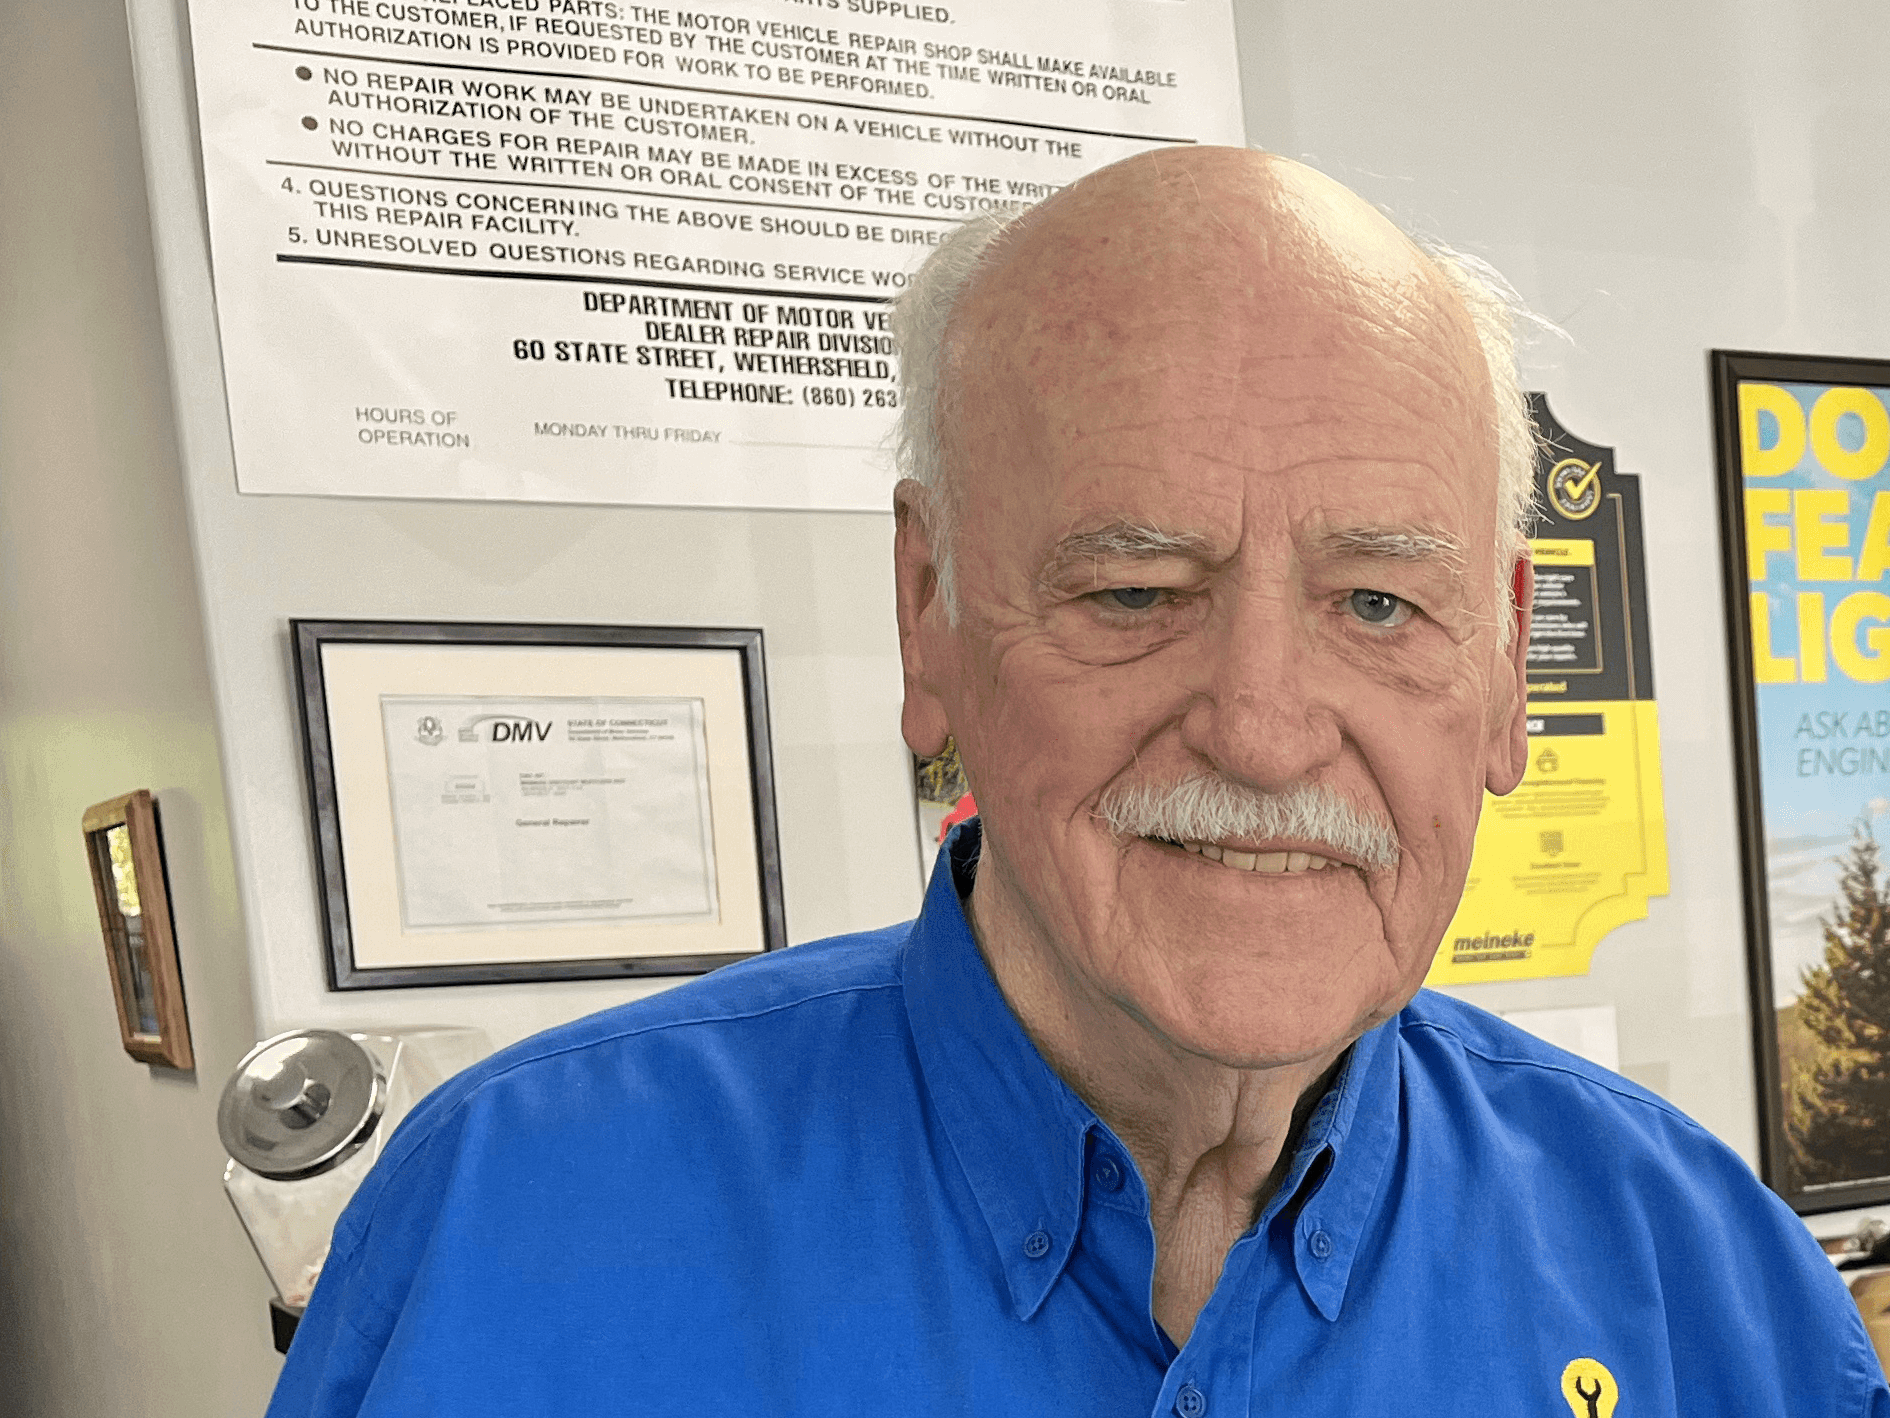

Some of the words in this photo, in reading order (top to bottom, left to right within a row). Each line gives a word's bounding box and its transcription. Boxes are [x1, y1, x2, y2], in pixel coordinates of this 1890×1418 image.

[294, 19, 471, 51] AUTHORIZATION
[480, 37, 499, 54] IS
[507, 39, 616, 63] PROVIDED
[623, 49, 664, 69] FOR
[674, 56, 739, 77] WORK
[745, 63, 772, 81] TO
[778, 67, 804, 84] BE
[810, 70, 934, 99] PERFORMED.
[331, 0, 370, 17] THE
[376, 2, 504, 32] CUSTOMER,
[509, 15, 527, 31] IF
[535, 17, 662, 45] REQUESTED
[669, 32, 696, 49] BY
[705, 35, 745, 54] THE
[751, 40, 860, 68] CUSTOMER
[865, 55, 888, 70] AT
[893, 58, 930, 76] THE
[936, 63, 981, 83] TIME
[987, 69, 1066, 94] WRITTEN
[1072, 81, 1097, 98] OR
[1102, 84, 1151, 104] ORAL
[631, 6, 671, 25] THE
[677, 11, 750, 34] MOTOR
[757, 20, 839, 45] VEHICLE
[848, 32, 917, 54] REPAIR
[924, 42, 972, 61] SHOP
[977, 49, 1033, 70] SHALL
[1037, 56, 1084, 77] MAKE
[1089, 63, 1177, 87] AVAILABLE
[324, 67, 357, 86] NO
[367, 73, 454, 95] REPAIR
[462, 80, 536, 103] WORK
[544, 87, 592, 106] MAY
[601, 92, 631, 110] BE
[639, 96, 790, 126] UNDERTAKEN
[797, 113, 828, 130] ON
[834, 118, 849, 133] A
[854, 118, 942, 142] VEHICLE
[948, 128, 1039, 151] WITHOUT
[1045, 139, 1082, 158] THE
[328, 89, 521, 121] AUTHORIZATION
[530, 107, 561, 124] OF
[569, 110, 615, 129] THE
[624, 116, 755, 144] CUSTOMER.
[330, 118, 363, 137] NO
[373, 123, 491, 147] CHARGES
[500, 133, 547, 151] FOR
[557, 137, 640, 160] REPAIR
[648, 146, 693, 165] MAY
[701, 152, 731, 169] BE
[738, 155, 801, 175] MADE
[807, 161, 828, 178] IN
[836, 164, 918, 186] EXCESS
[927, 173, 955, 189] OF
[961, 176, 1001, 194] THE
[331, 140, 442, 165] WITHOUT
[449, 150, 498, 169] THE
[508, 154, 612, 177] WRITTEN
[621, 164, 652, 182] OR
[660, 168, 722, 189] ORAL
[729, 174, 833, 198] CONSENT
[840, 184, 868, 200] OF
[873, 187, 915, 206] THE
[281, 177, 301, 194] 4.
[309, 179, 448, 207] QUESTIONS
[456, 192, 618, 219] CONCERNING
[625, 204, 670, 223] THE
[677, 210, 753, 232] ABOVE
[760, 216, 849, 238] SHOULD
[856, 225, 884, 241] BE
[313, 201, 368, 221] THIS
[376, 206, 462, 229] REPAIR
[471, 214, 579, 237] FACILITY.
[288, 226, 308, 244] 5.
[316, 228, 476, 257] UNRESOLVED
[489, 243, 625, 267] QUESTIONS
[633, 252, 765, 278] REGARDING
[774, 263, 865, 285] SERVICE
[583, 291, 734, 323] DEPARTMENT
[743, 305, 769, 324] OF
[777, 307, 854, 329] MOTOR
[645, 321, 726, 346] DEALER
[734, 327, 810, 351] REPAIR
[513, 339, 544, 360] 60
[554, 341, 629, 364] STATE
[636, 346, 724, 374] STREET,
[733, 351, 896, 383] WETHERSFIELD,
[665, 377, 793, 405] TELEPHONE:
[802, 387, 856, 409] (860)
[356, 406, 426, 425] HOURS
[431, 409, 457, 426] OF
[534, 420, 607, 439] MONDAY
[613, 424, 659, 441] THRU
[664, 427, 722, 444] FRIDAY
[358, 428, 470, 449] OPERATION
[491, 720, 553, 742] DMV
[1794, 709, 1848, 740] ASK
[1453, 930, 1535, 951] meineke
